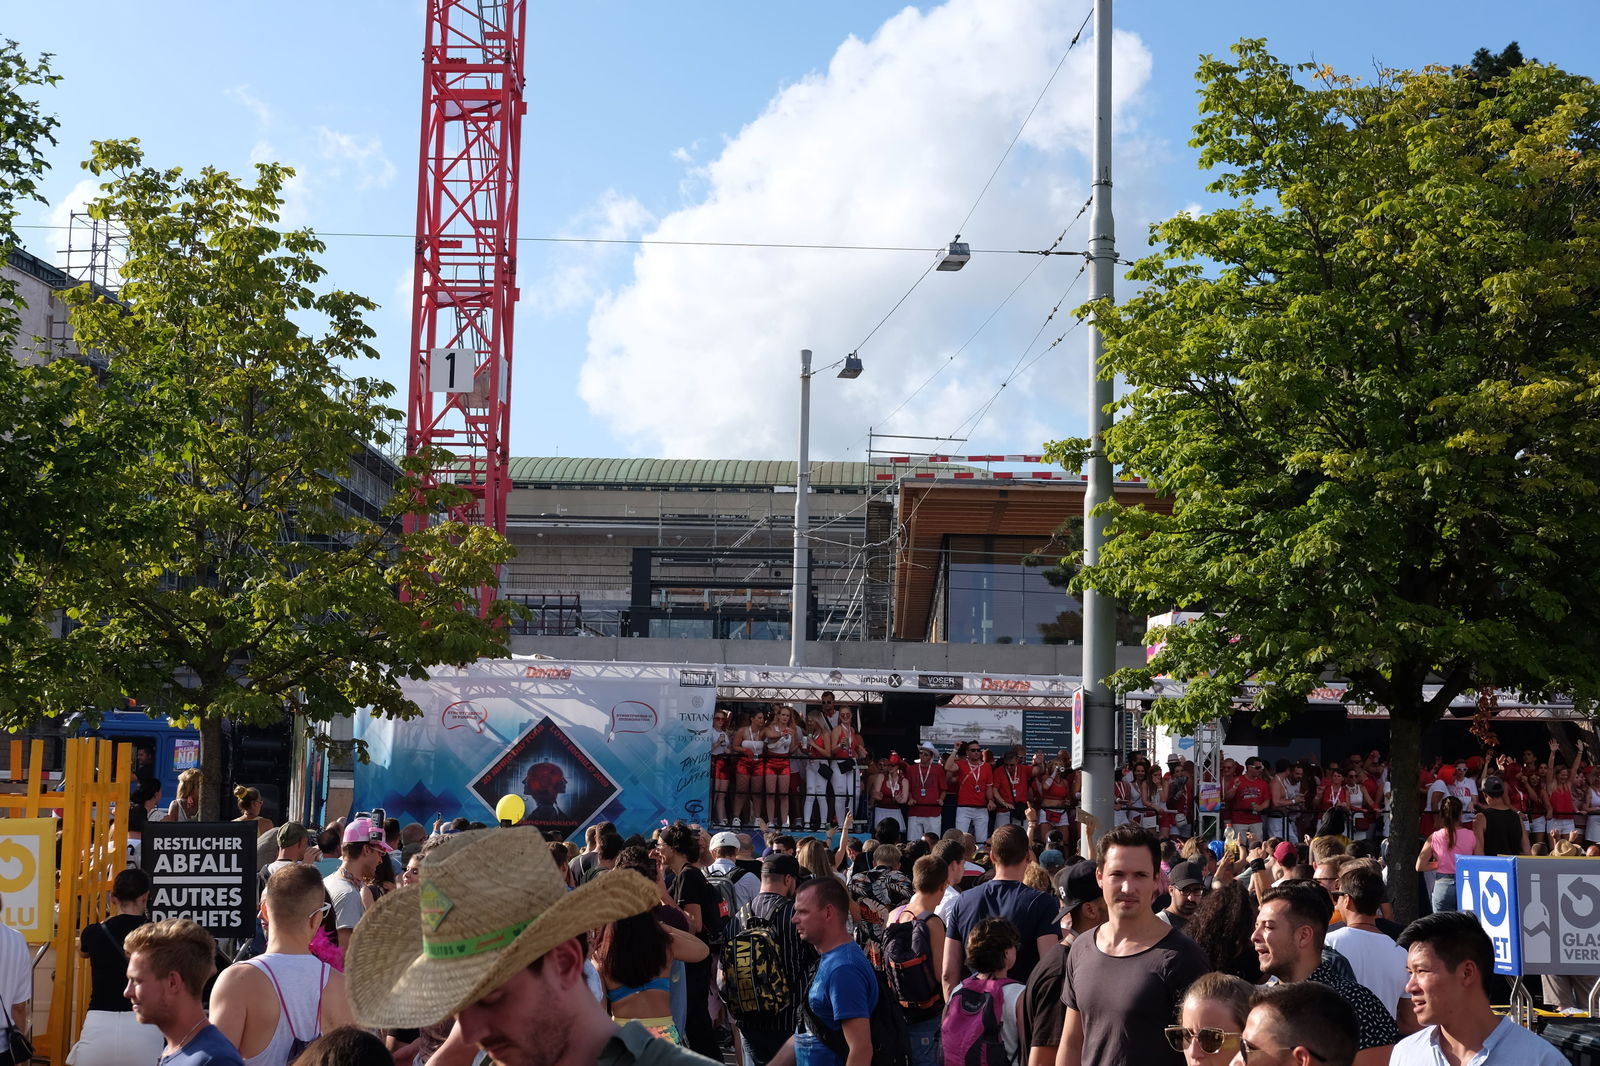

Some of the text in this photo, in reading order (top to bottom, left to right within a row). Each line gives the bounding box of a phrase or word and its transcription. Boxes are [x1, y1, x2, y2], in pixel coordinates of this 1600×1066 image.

[445, 352, 456, 388] 1
[682, 672, 714, 685] MIND-X
[927, 676, 955, 684] VOSER
[1246, 686, 1263, 694] VOS
[177, 751, 195, 762] NO
[153, 837, 242, 851] RESTLICHER
[153, 853, 243, 873] ABFALL
[152, 887, 243, 907] AUTRES
[5, 906, 35, 927] LU
[1493, 936, 1509, 960] ET
[1563, 948, 1600, 961] VERR
